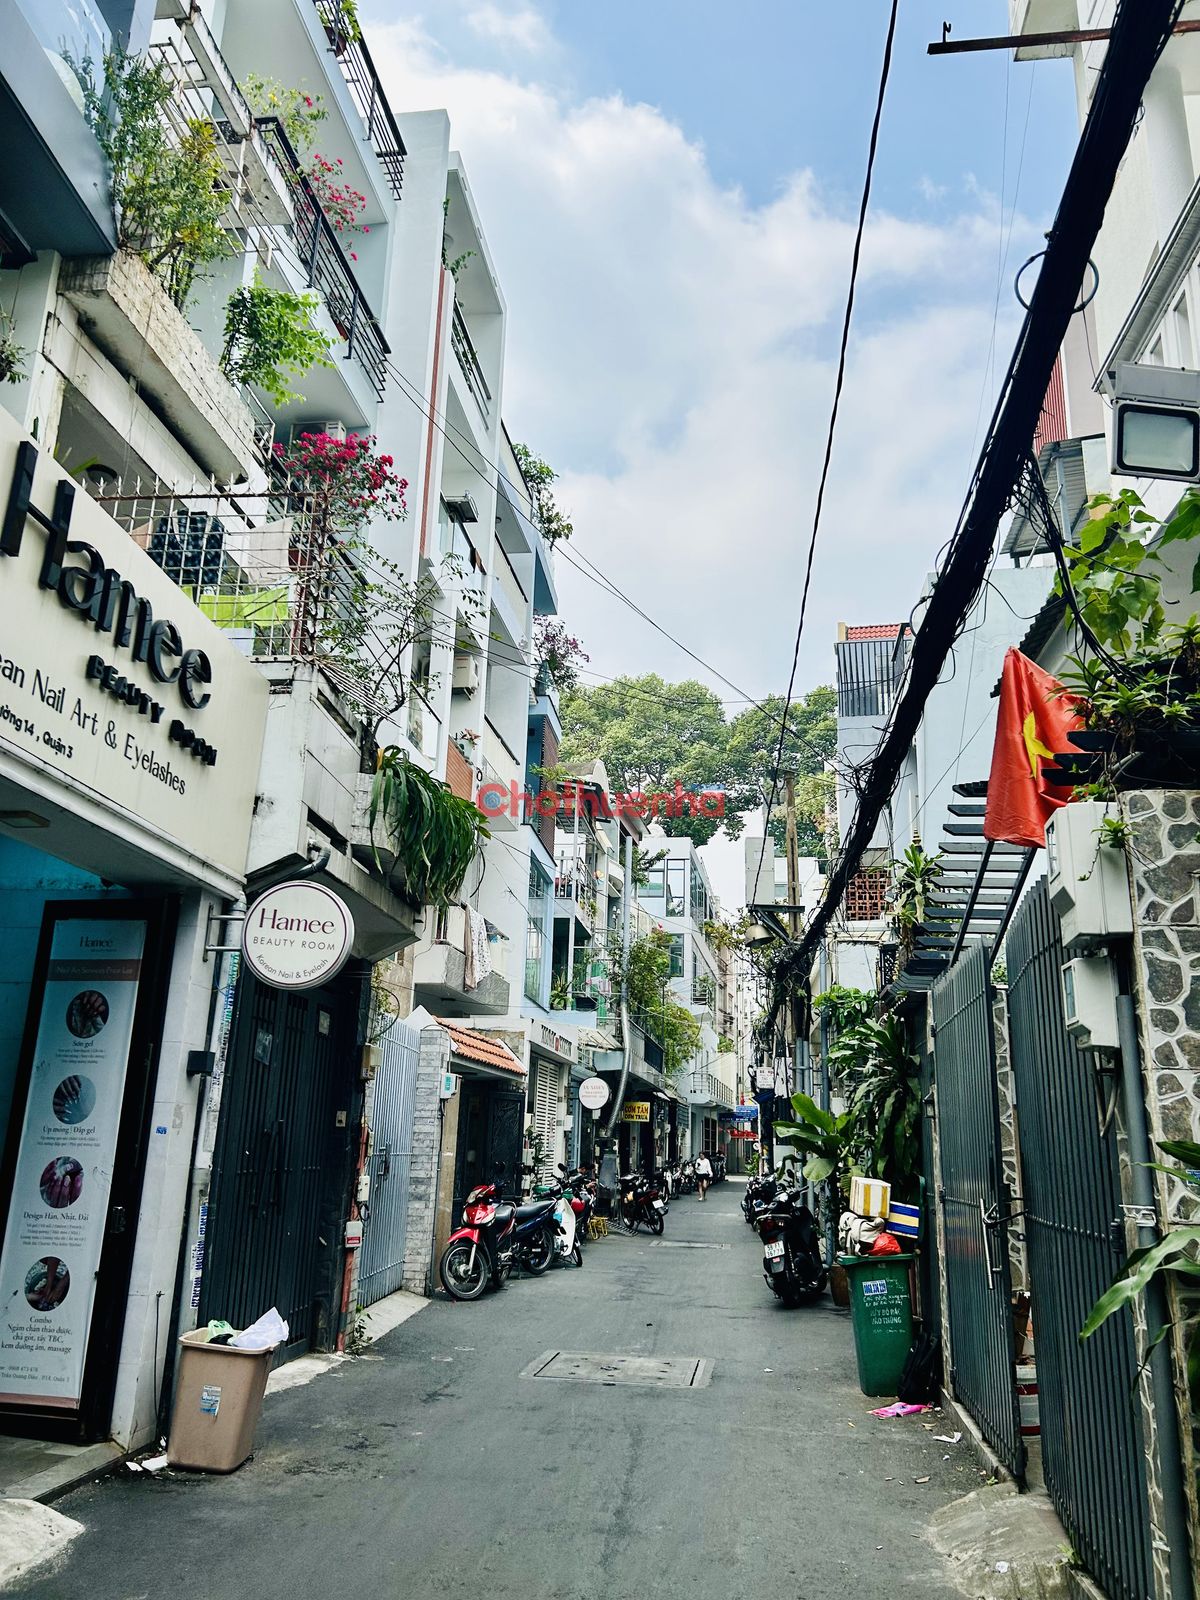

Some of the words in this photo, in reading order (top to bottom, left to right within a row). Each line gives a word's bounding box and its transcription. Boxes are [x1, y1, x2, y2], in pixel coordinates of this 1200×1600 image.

[0, 440, 212, 710] Hamee
[86, 655, 165, 723] BEAUTY
[170, 720, 217, 766] ROOM
[32, 669, 66, 714] Nail
[70, 698, 98, 736] Art
[105, 720, 117, 749] &
[124, 733, 186, 795] Eyelashes
[43, 731, 66, 756] Quận
[259, 908, 336, 934] Hamee
[253, 936, 295, 947] BEAUTY
[301, 941, 335, 951] ROOM
[256, 954, 276, 975] Korean
[278, 970, 293, 979] Nail
[303, 959, 328, 977] Eyelash
[30, 1316, 52, 1324] Combo
[47, 1345, 72, 1355] massage
